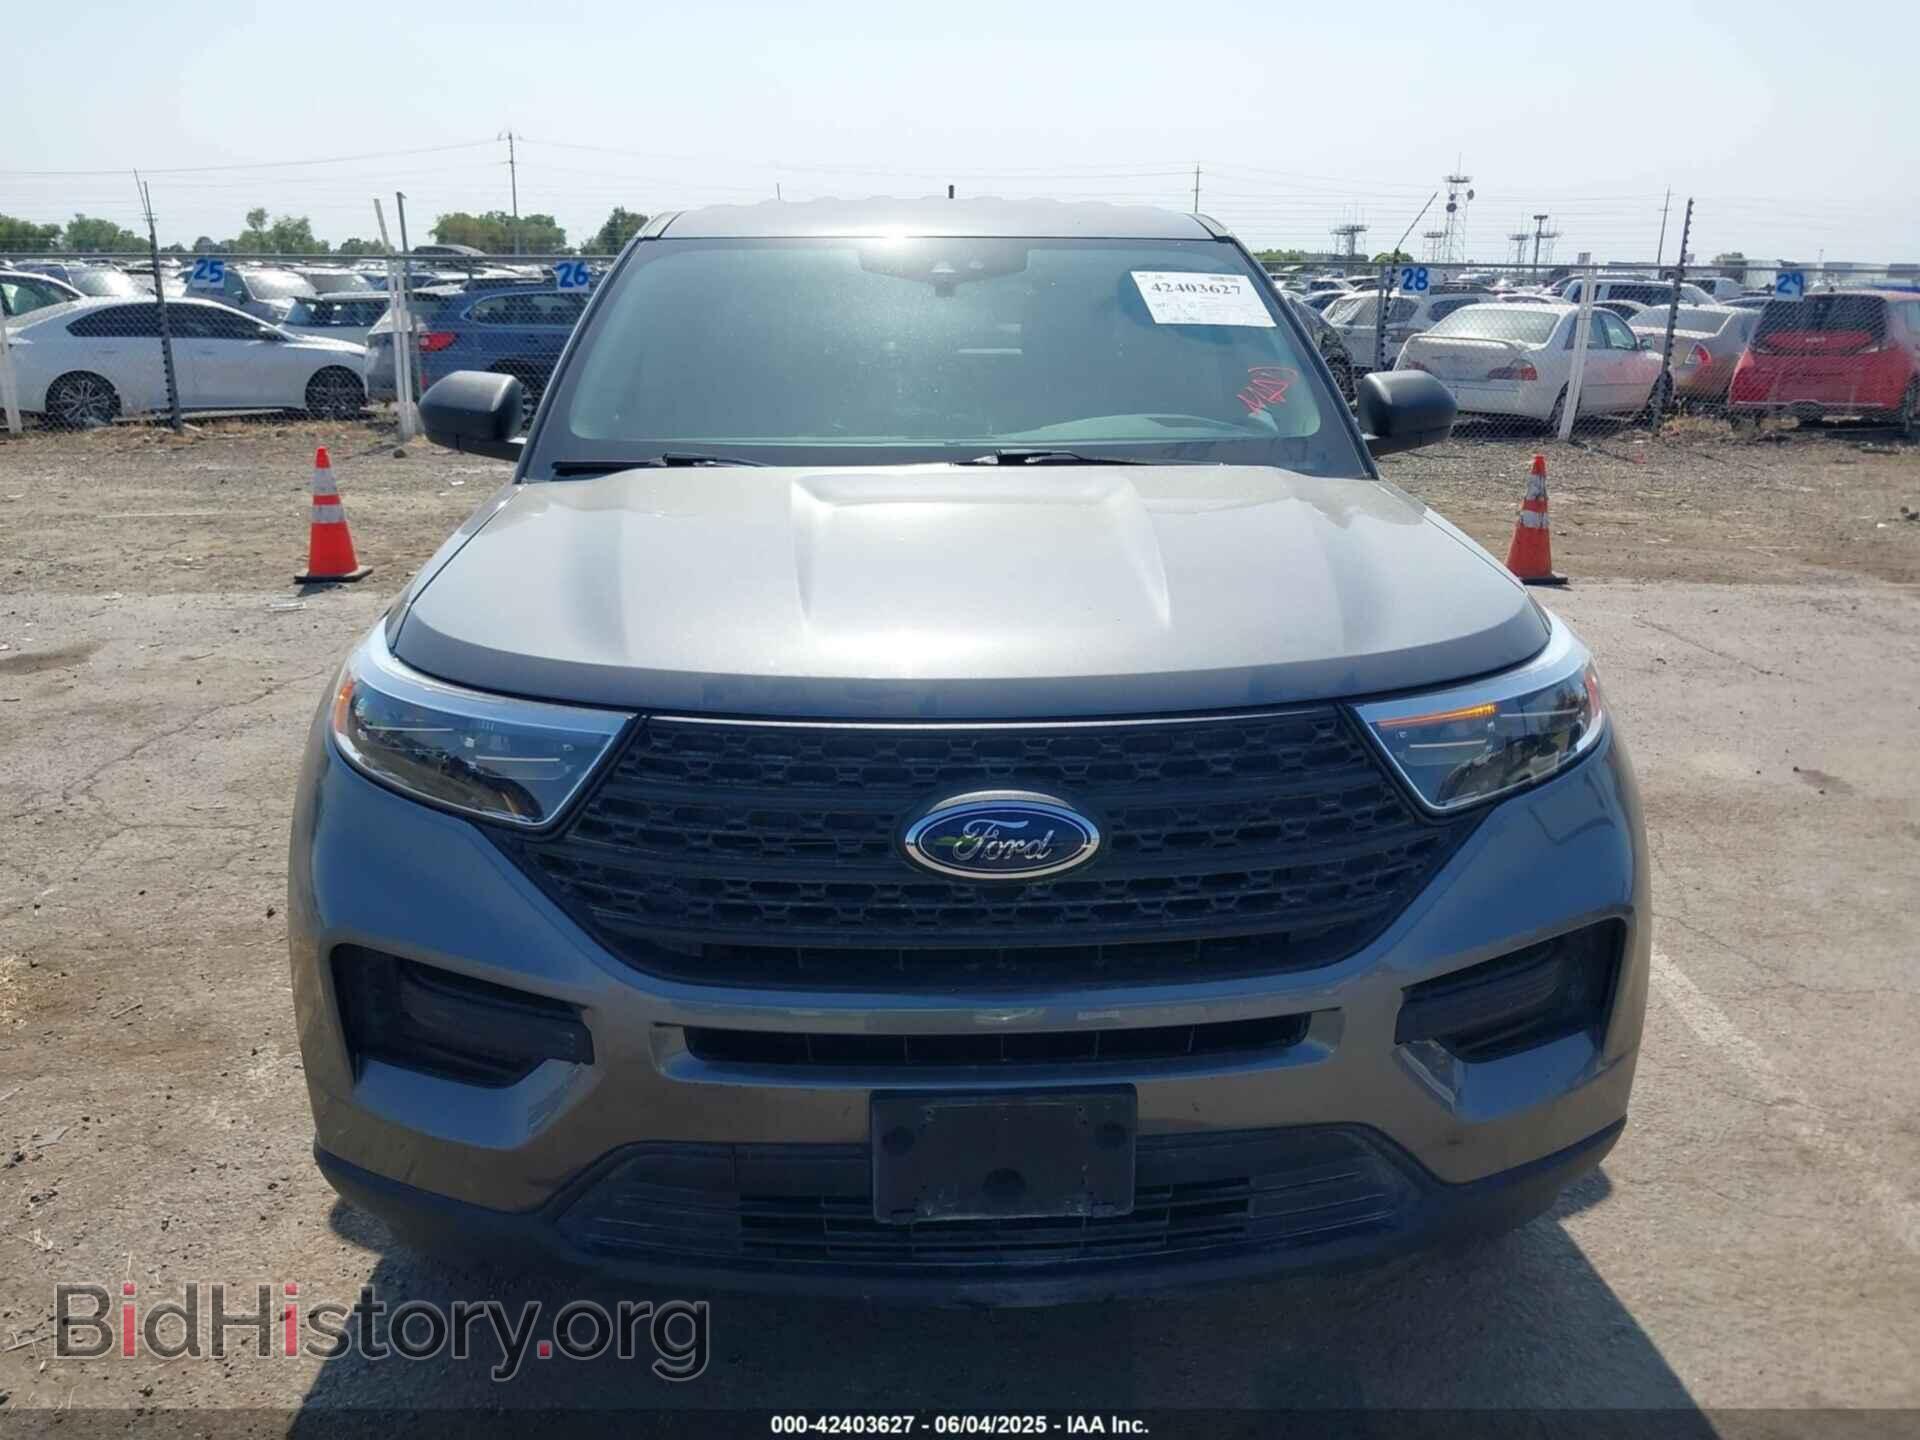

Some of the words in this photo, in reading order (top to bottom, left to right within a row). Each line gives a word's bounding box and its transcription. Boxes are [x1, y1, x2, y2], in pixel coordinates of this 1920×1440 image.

[194, 259, 224, 283] 25
[556, 263, 589, 288] 26
[1401, 267, 1429, 291] 28
[1151, 282, 1241, 295] 42403627
[1777, 271, 1805, 296] 29
[952, 818, 1055, 861] Ford
